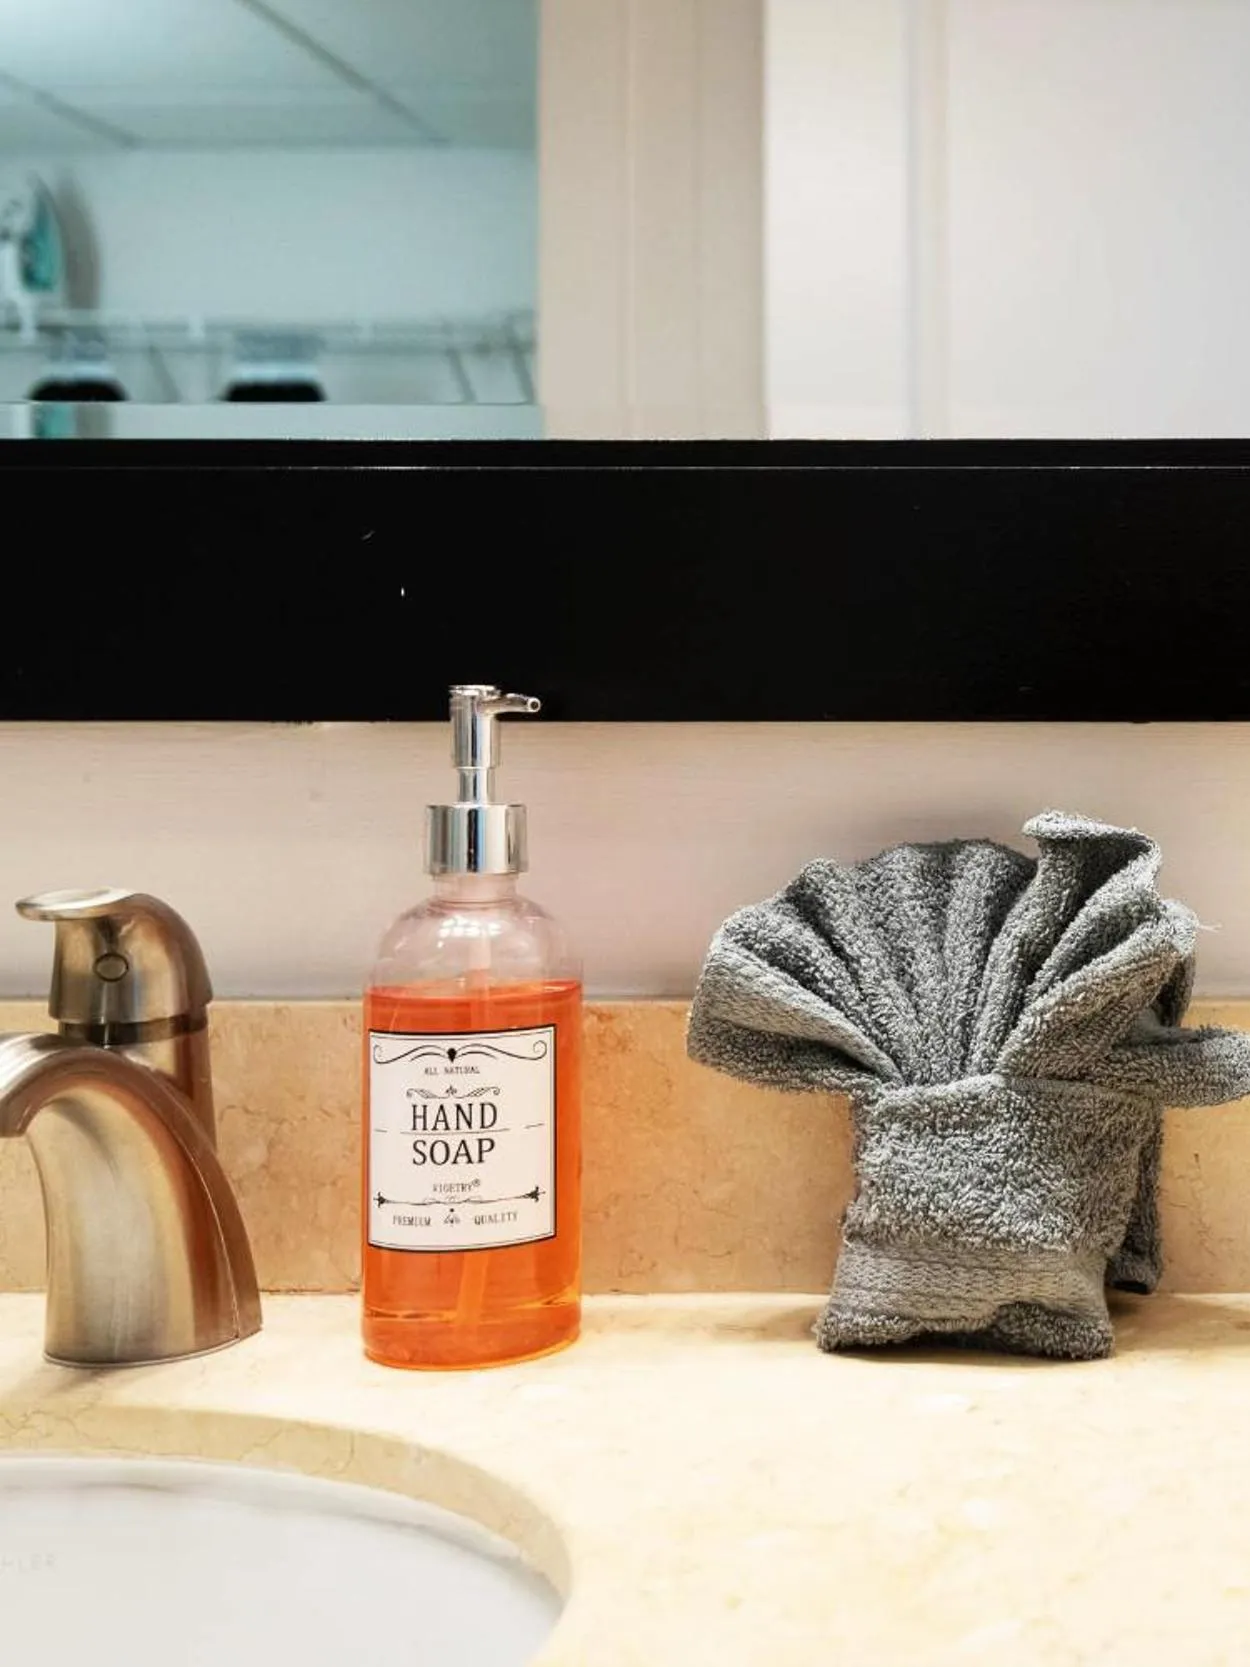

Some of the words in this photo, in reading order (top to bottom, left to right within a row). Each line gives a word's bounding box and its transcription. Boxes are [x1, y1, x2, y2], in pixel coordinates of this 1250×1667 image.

[444, 1065, 480, 1075] NATURAL
[411, 1102, 498, 1131] HAND
[412, 1137, 496, 1166] SOAP
[392, 1215, 431, 1227] PREMIUM
[474, 1211, 518, 1226] QUALITY
